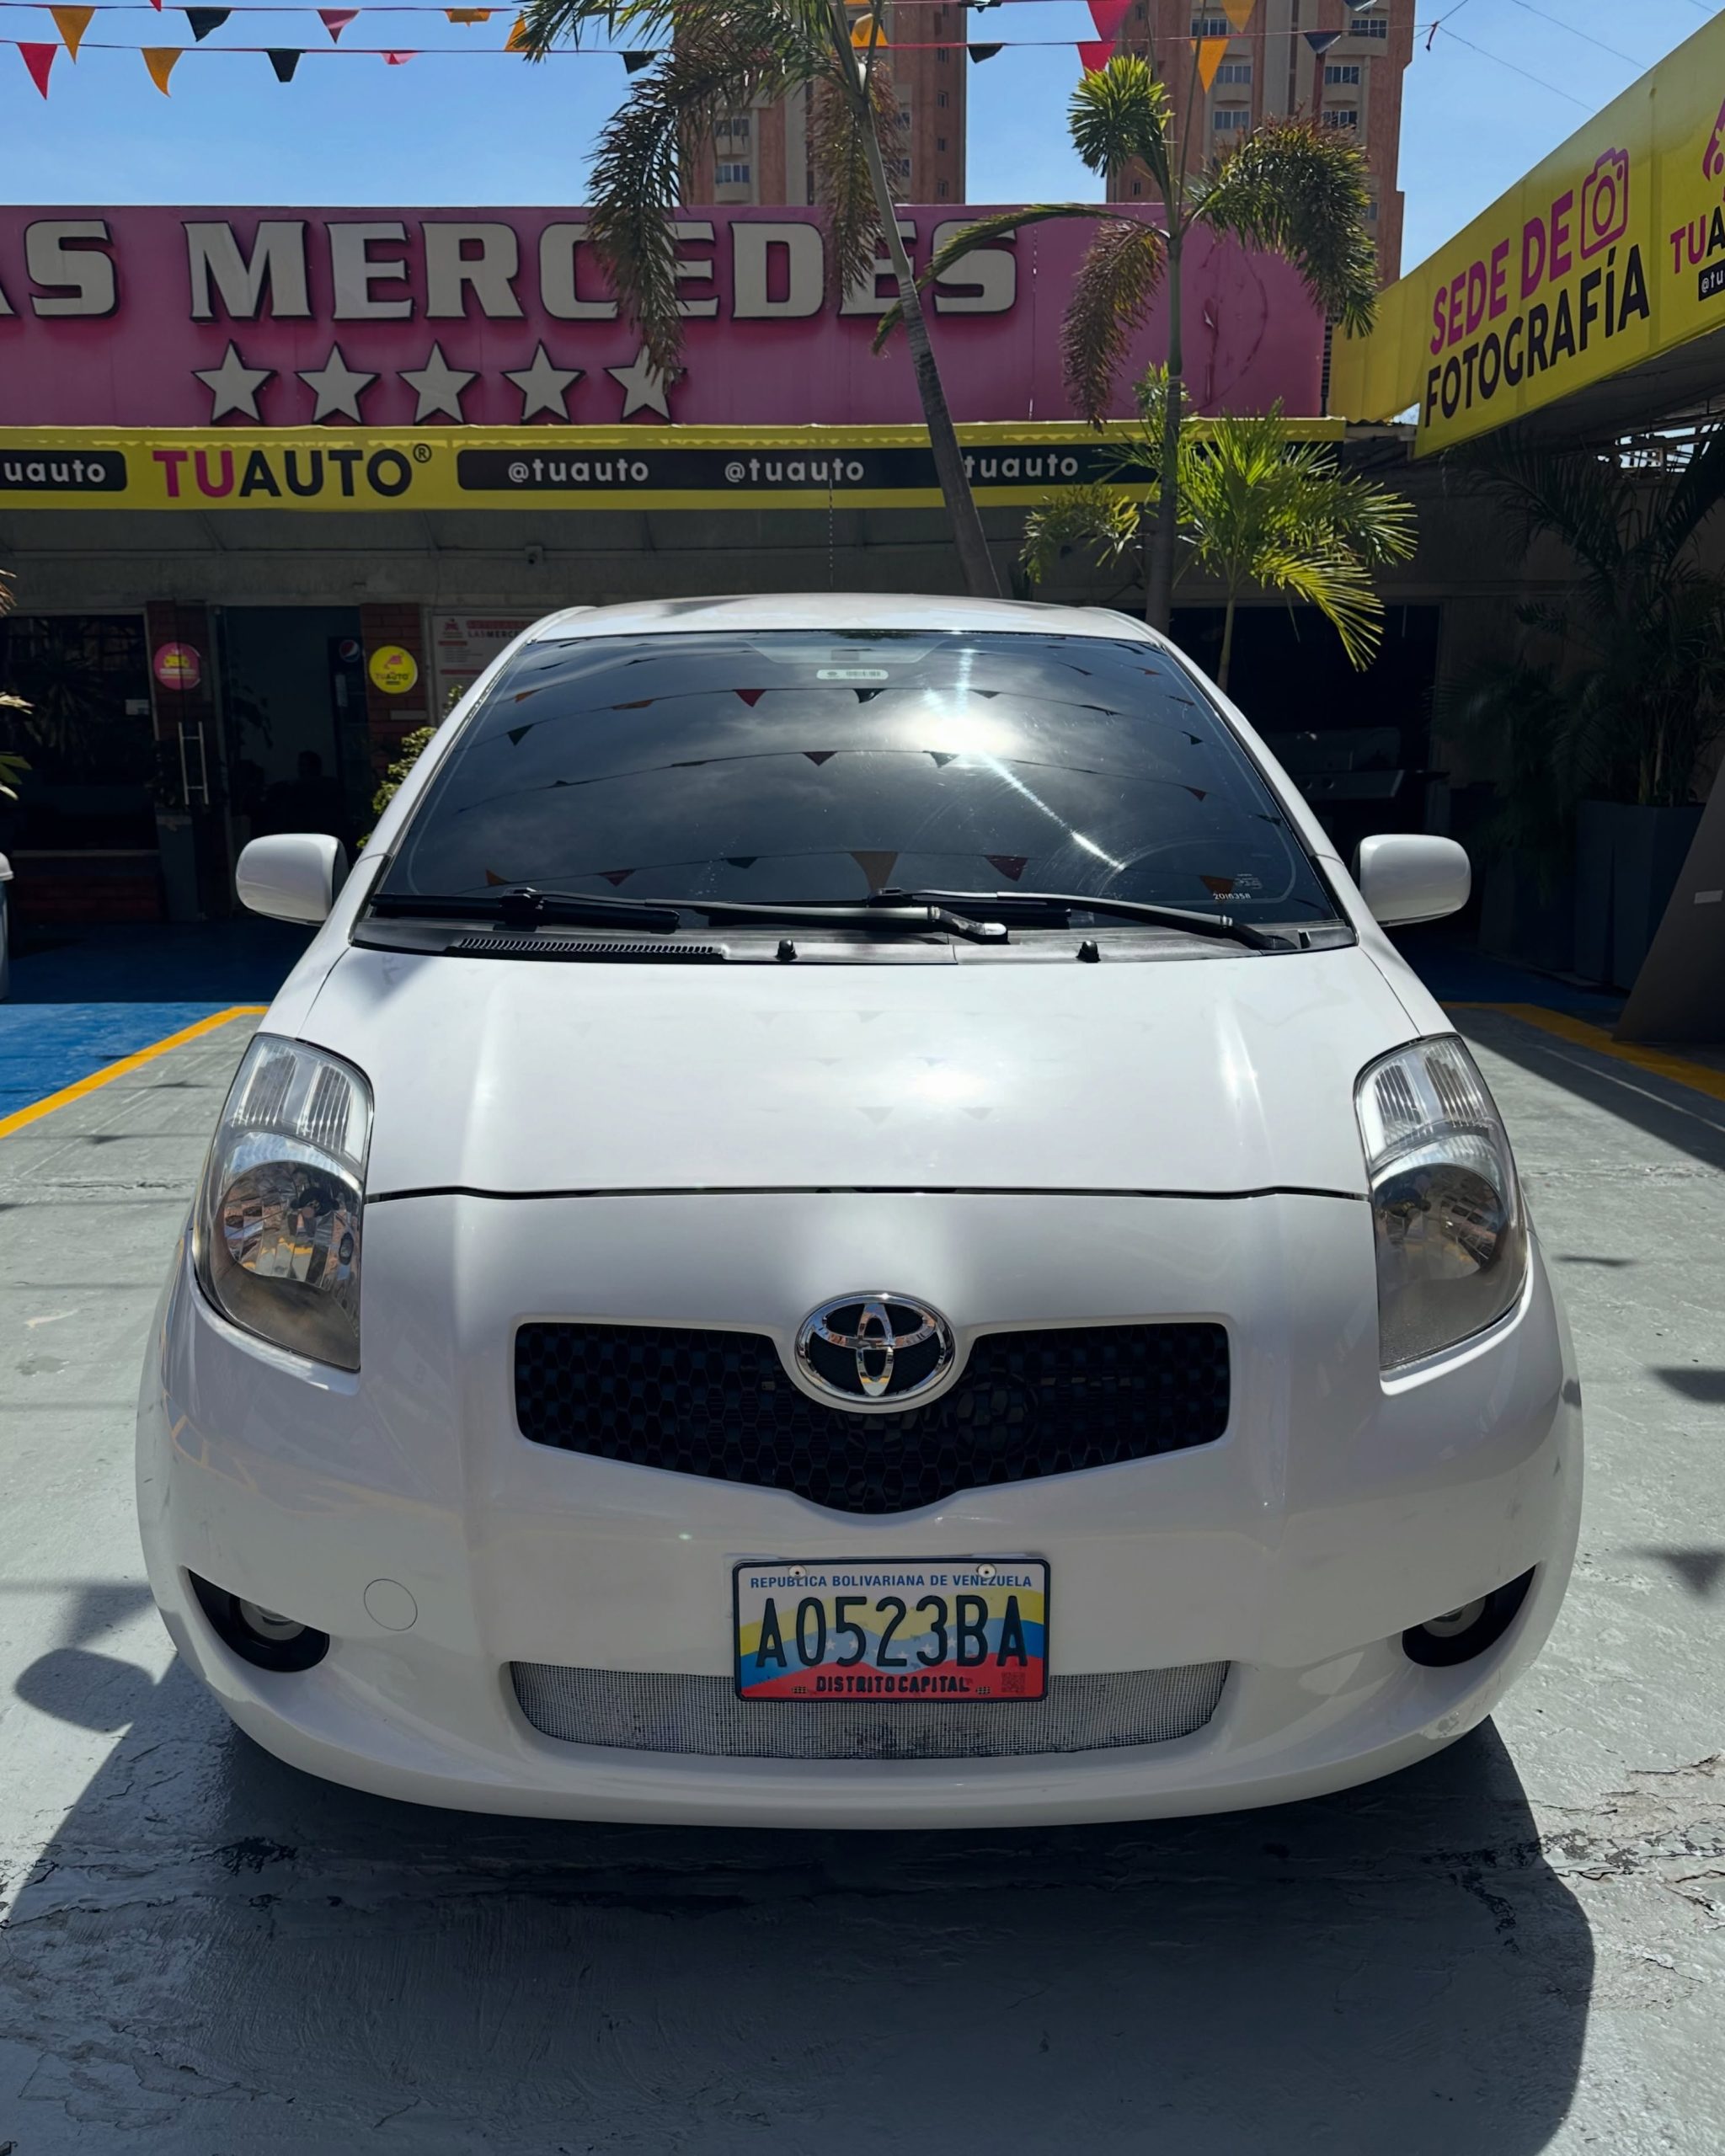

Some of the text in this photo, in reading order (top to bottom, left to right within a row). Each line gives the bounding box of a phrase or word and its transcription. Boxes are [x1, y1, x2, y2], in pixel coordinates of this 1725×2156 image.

[1429, 189, 1573, 355] SEDE DE
[1424, 243, 1650, 428] FOTOGRAFÍA
[4, 460, 106, 483] uauto
[508, 457, 649, 483] @tuauto
[724, 457, 864, 482] @tuauto
[832, 1575, 925, 1587] BOLIVARIANA
[931, 1575, 948, 1586] DE
[953, 1575, 1032, 1588] VENEZUELA
[756, 1594, 1028, 1668] A0523BA
